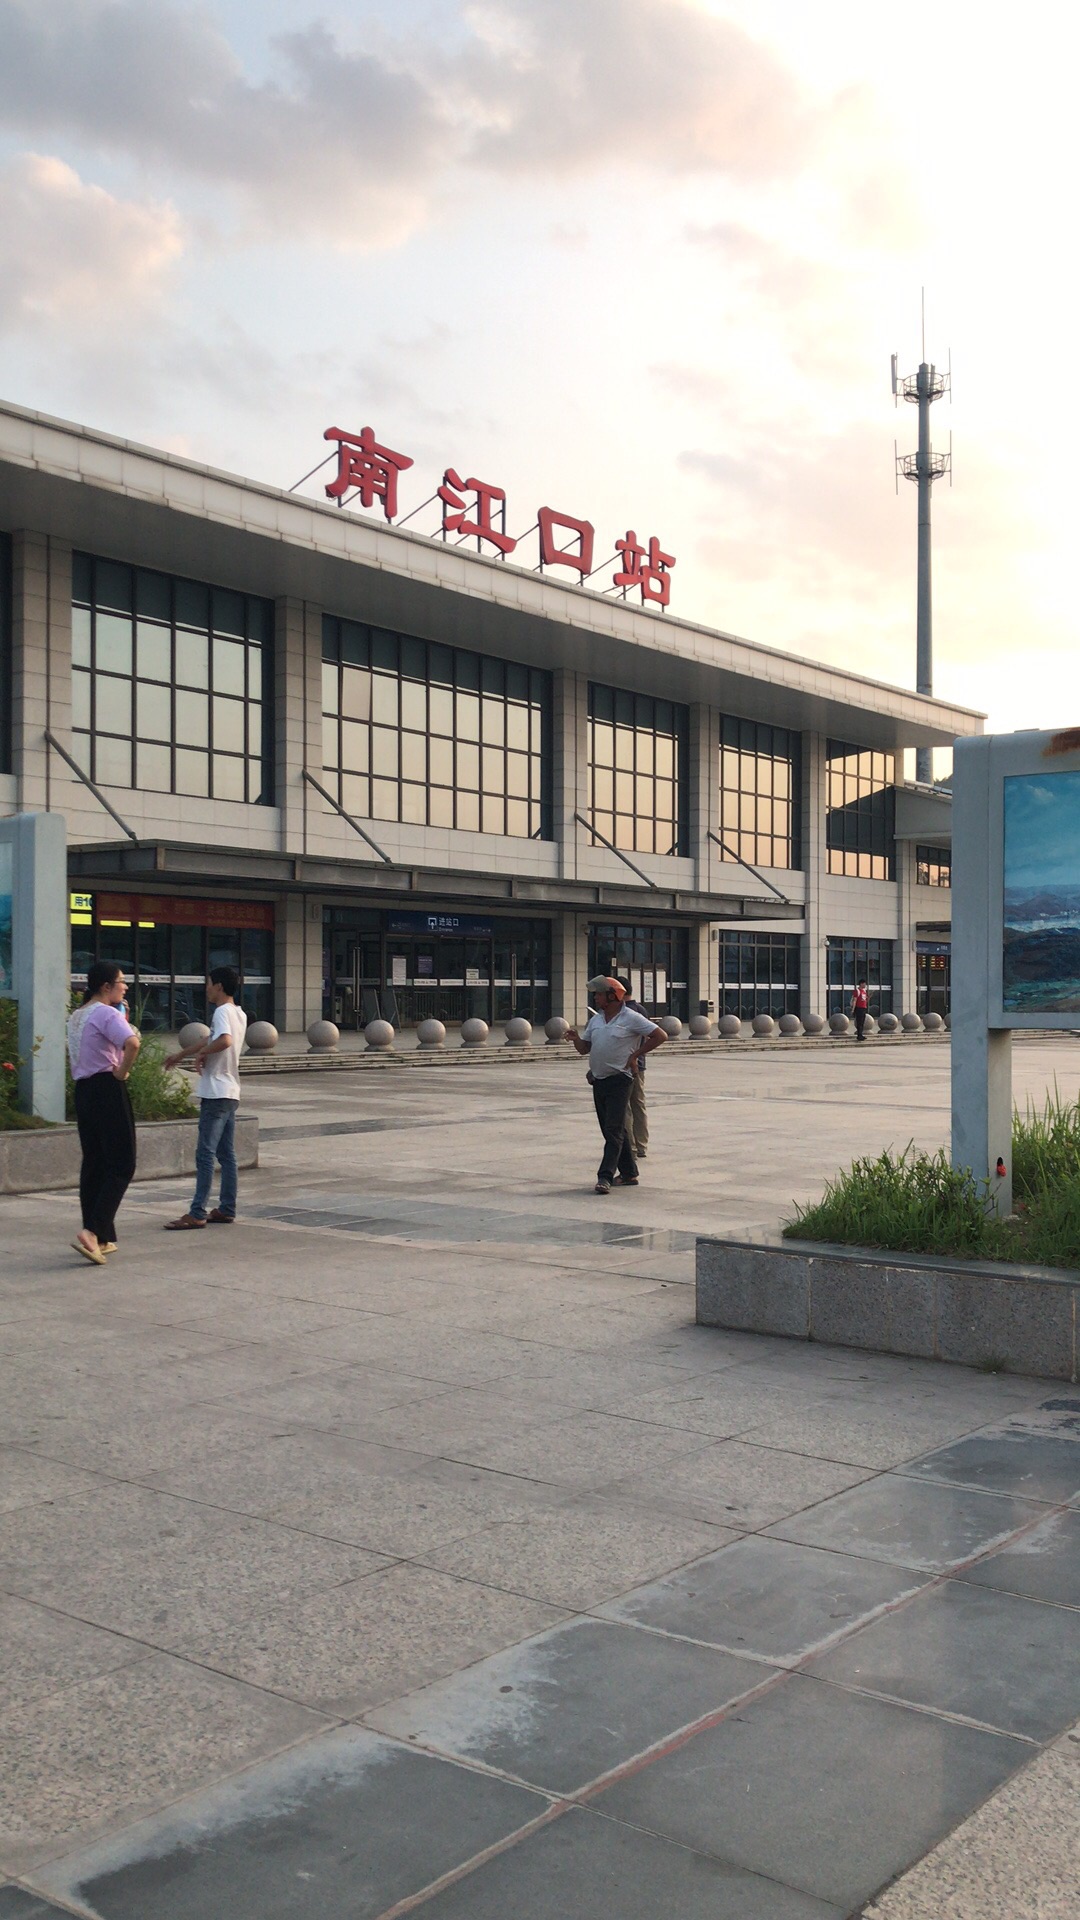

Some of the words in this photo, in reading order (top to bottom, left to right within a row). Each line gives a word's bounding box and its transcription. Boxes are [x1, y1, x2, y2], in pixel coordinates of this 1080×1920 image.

[326, 428, 675, 605] 南江口站
[438, 916, 459, 927] 进站口
